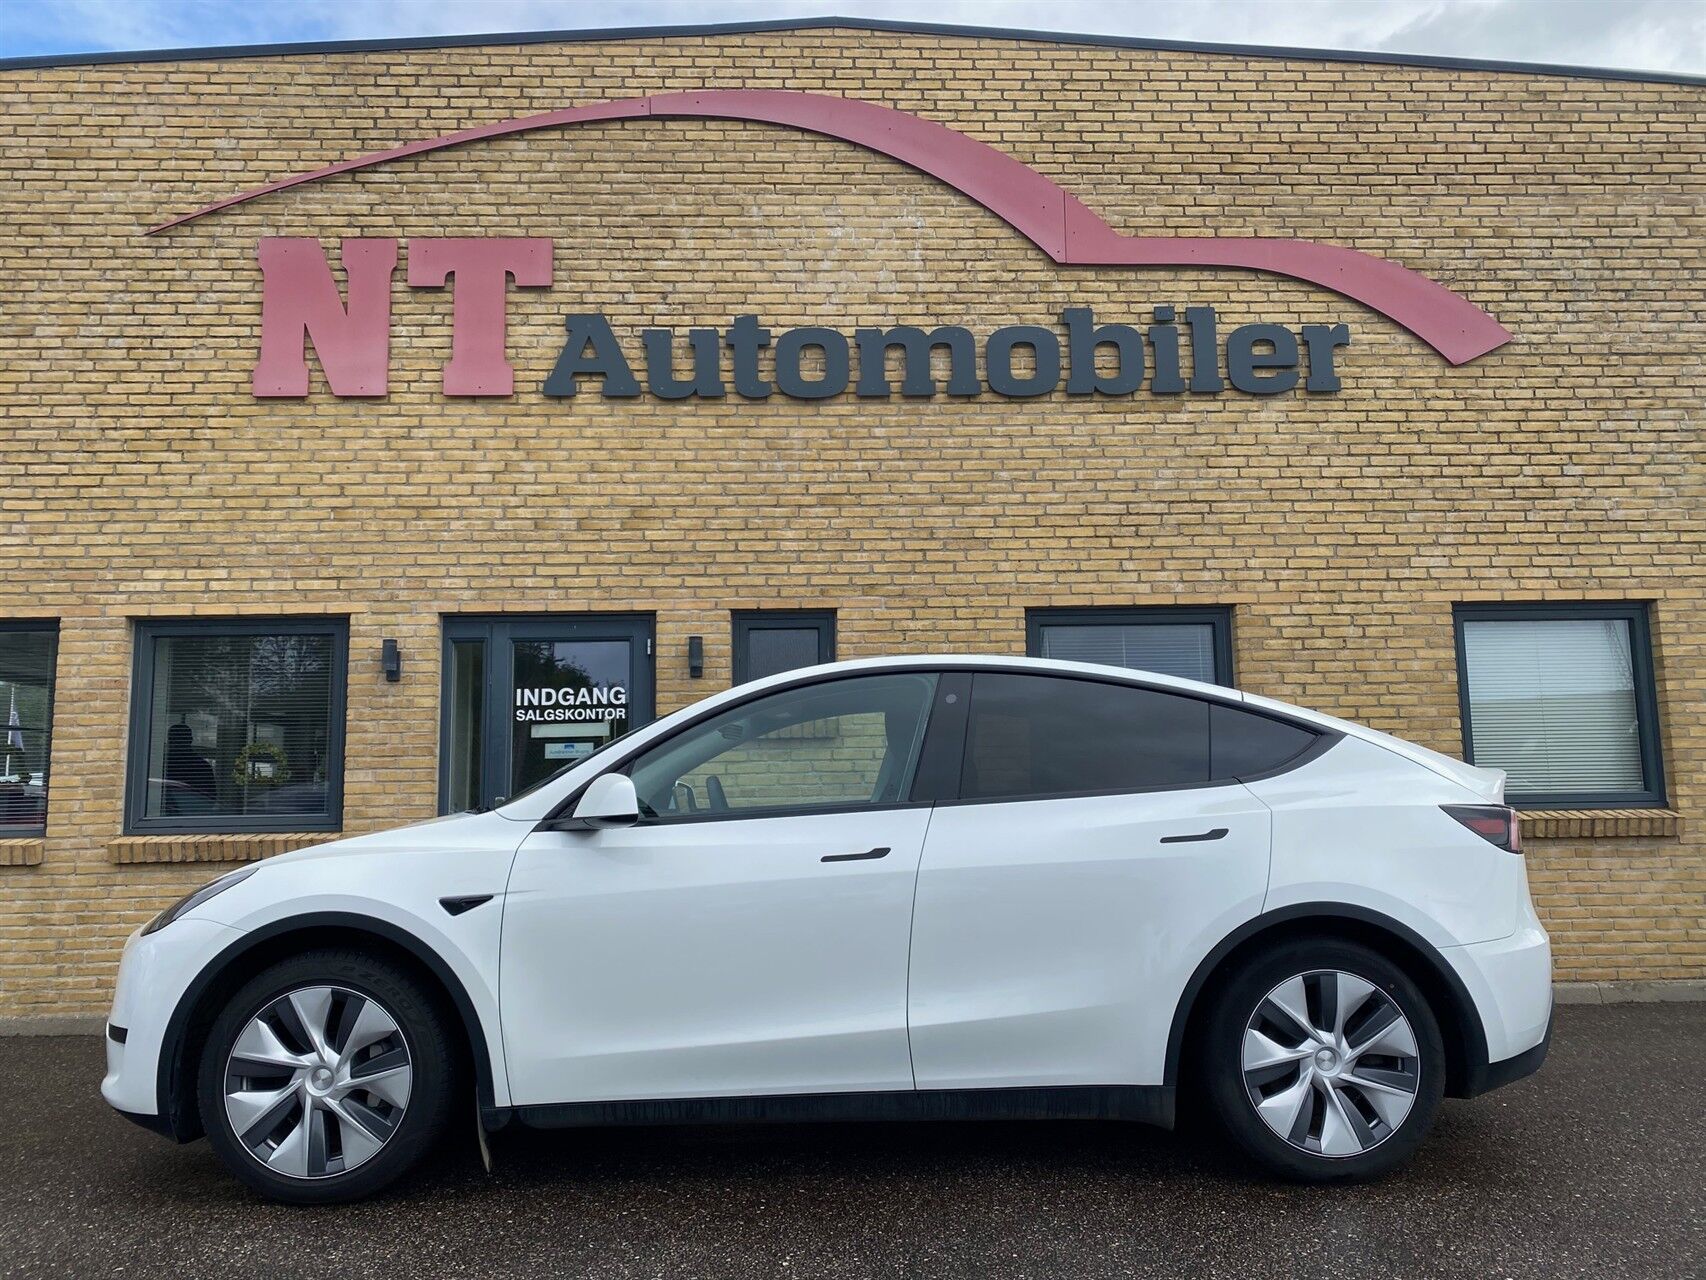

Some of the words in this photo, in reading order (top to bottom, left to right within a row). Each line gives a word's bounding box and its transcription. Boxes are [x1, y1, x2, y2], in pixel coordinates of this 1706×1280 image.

[252, 236, 554, 397] NT
[543, 306, 1349, 398] Automobiler
[516, 687, 626, 706] INDGANG
[516, 708, 626, 721] SALGSKONTOR
